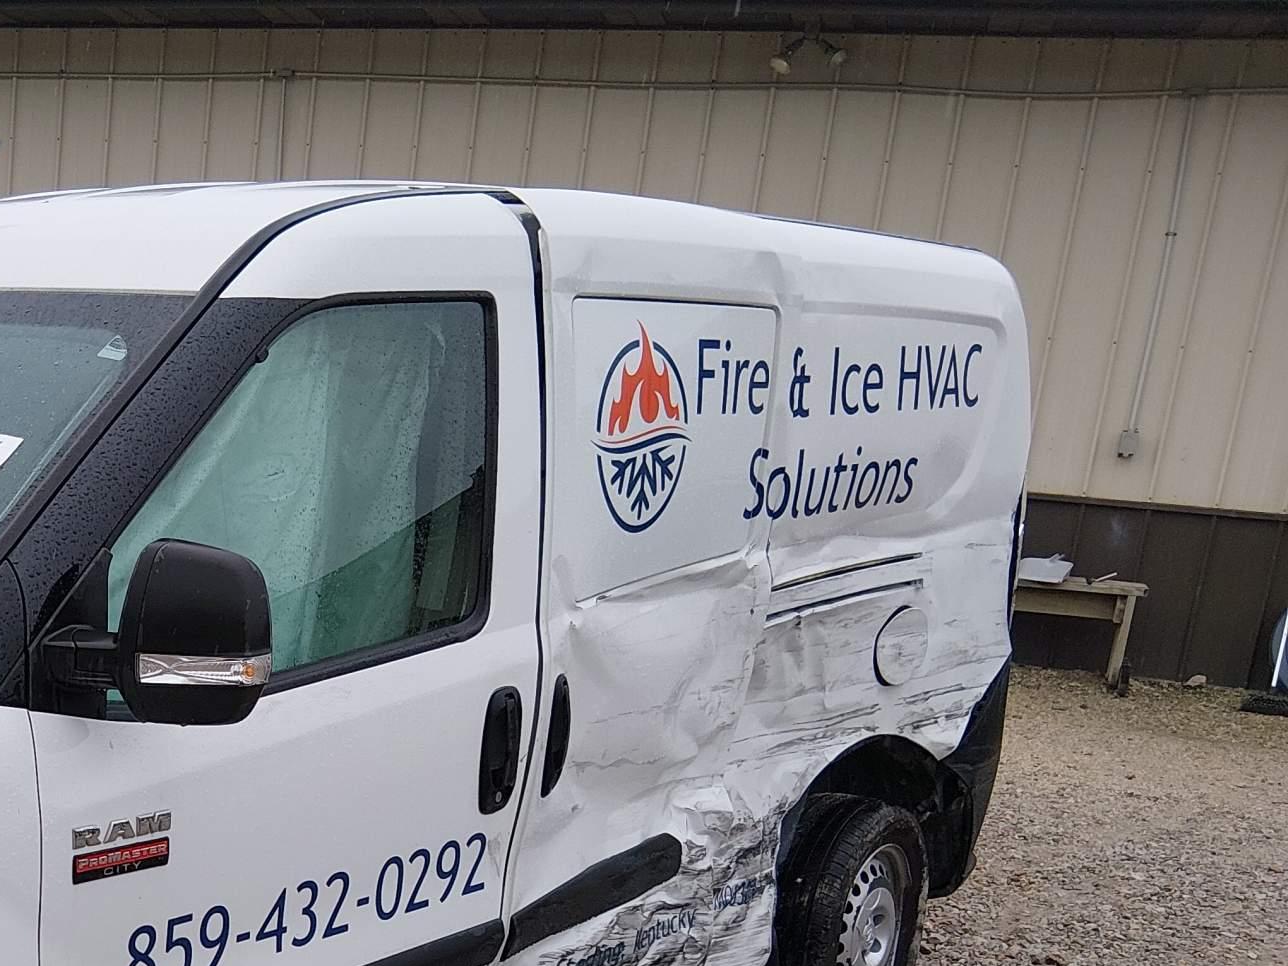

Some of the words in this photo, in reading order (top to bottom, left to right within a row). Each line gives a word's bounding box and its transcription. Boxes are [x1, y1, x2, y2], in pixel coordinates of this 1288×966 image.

[696, 339, 770, 416] Fire
[789, 347, 811, 418] &
[830, 347, 884, 416] Ice
[897, 343, 983, 412] HVAC
[742, 446, 919, 520] Solutions
[71, 809, 172, 850] RAM
[103, 861, 141, 876] CITY
